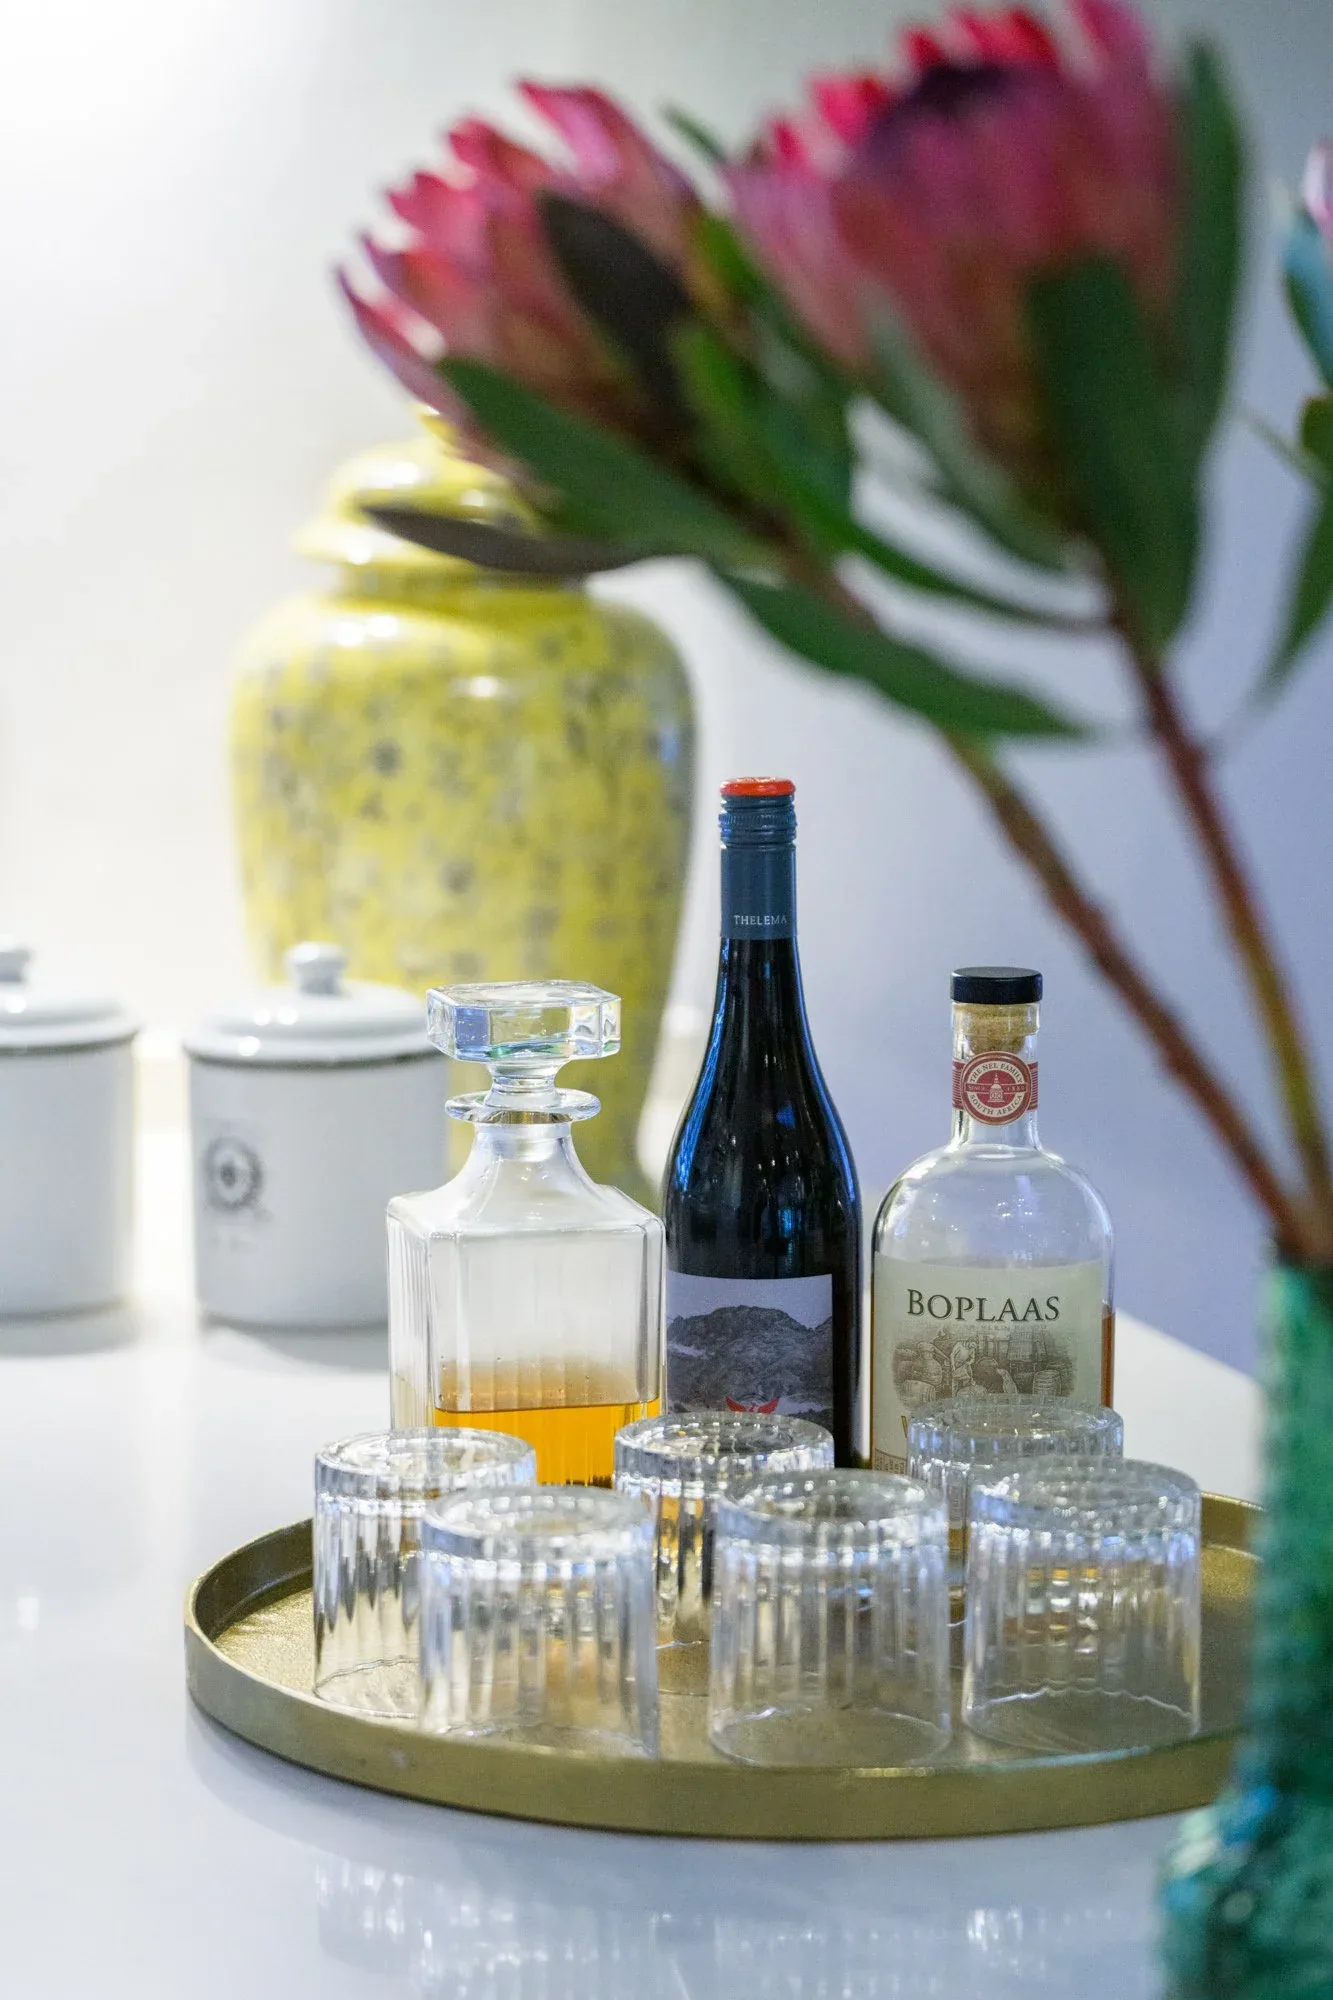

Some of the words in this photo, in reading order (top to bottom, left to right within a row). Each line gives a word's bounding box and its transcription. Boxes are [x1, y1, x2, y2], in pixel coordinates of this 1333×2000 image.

[733, 914, 787, 926] THELEMA
[970, 1069, 982, 1083] THE
[983, 1062, 999, 1071] NEL
[1000, 1063, 1023, 1083] FAMILY
[970, 1094, 994, 1115] SOUTH
[997, 1095, 1023, 1115] AFRICA
[907, 1288, 1060, 1322] BOPLAAS
